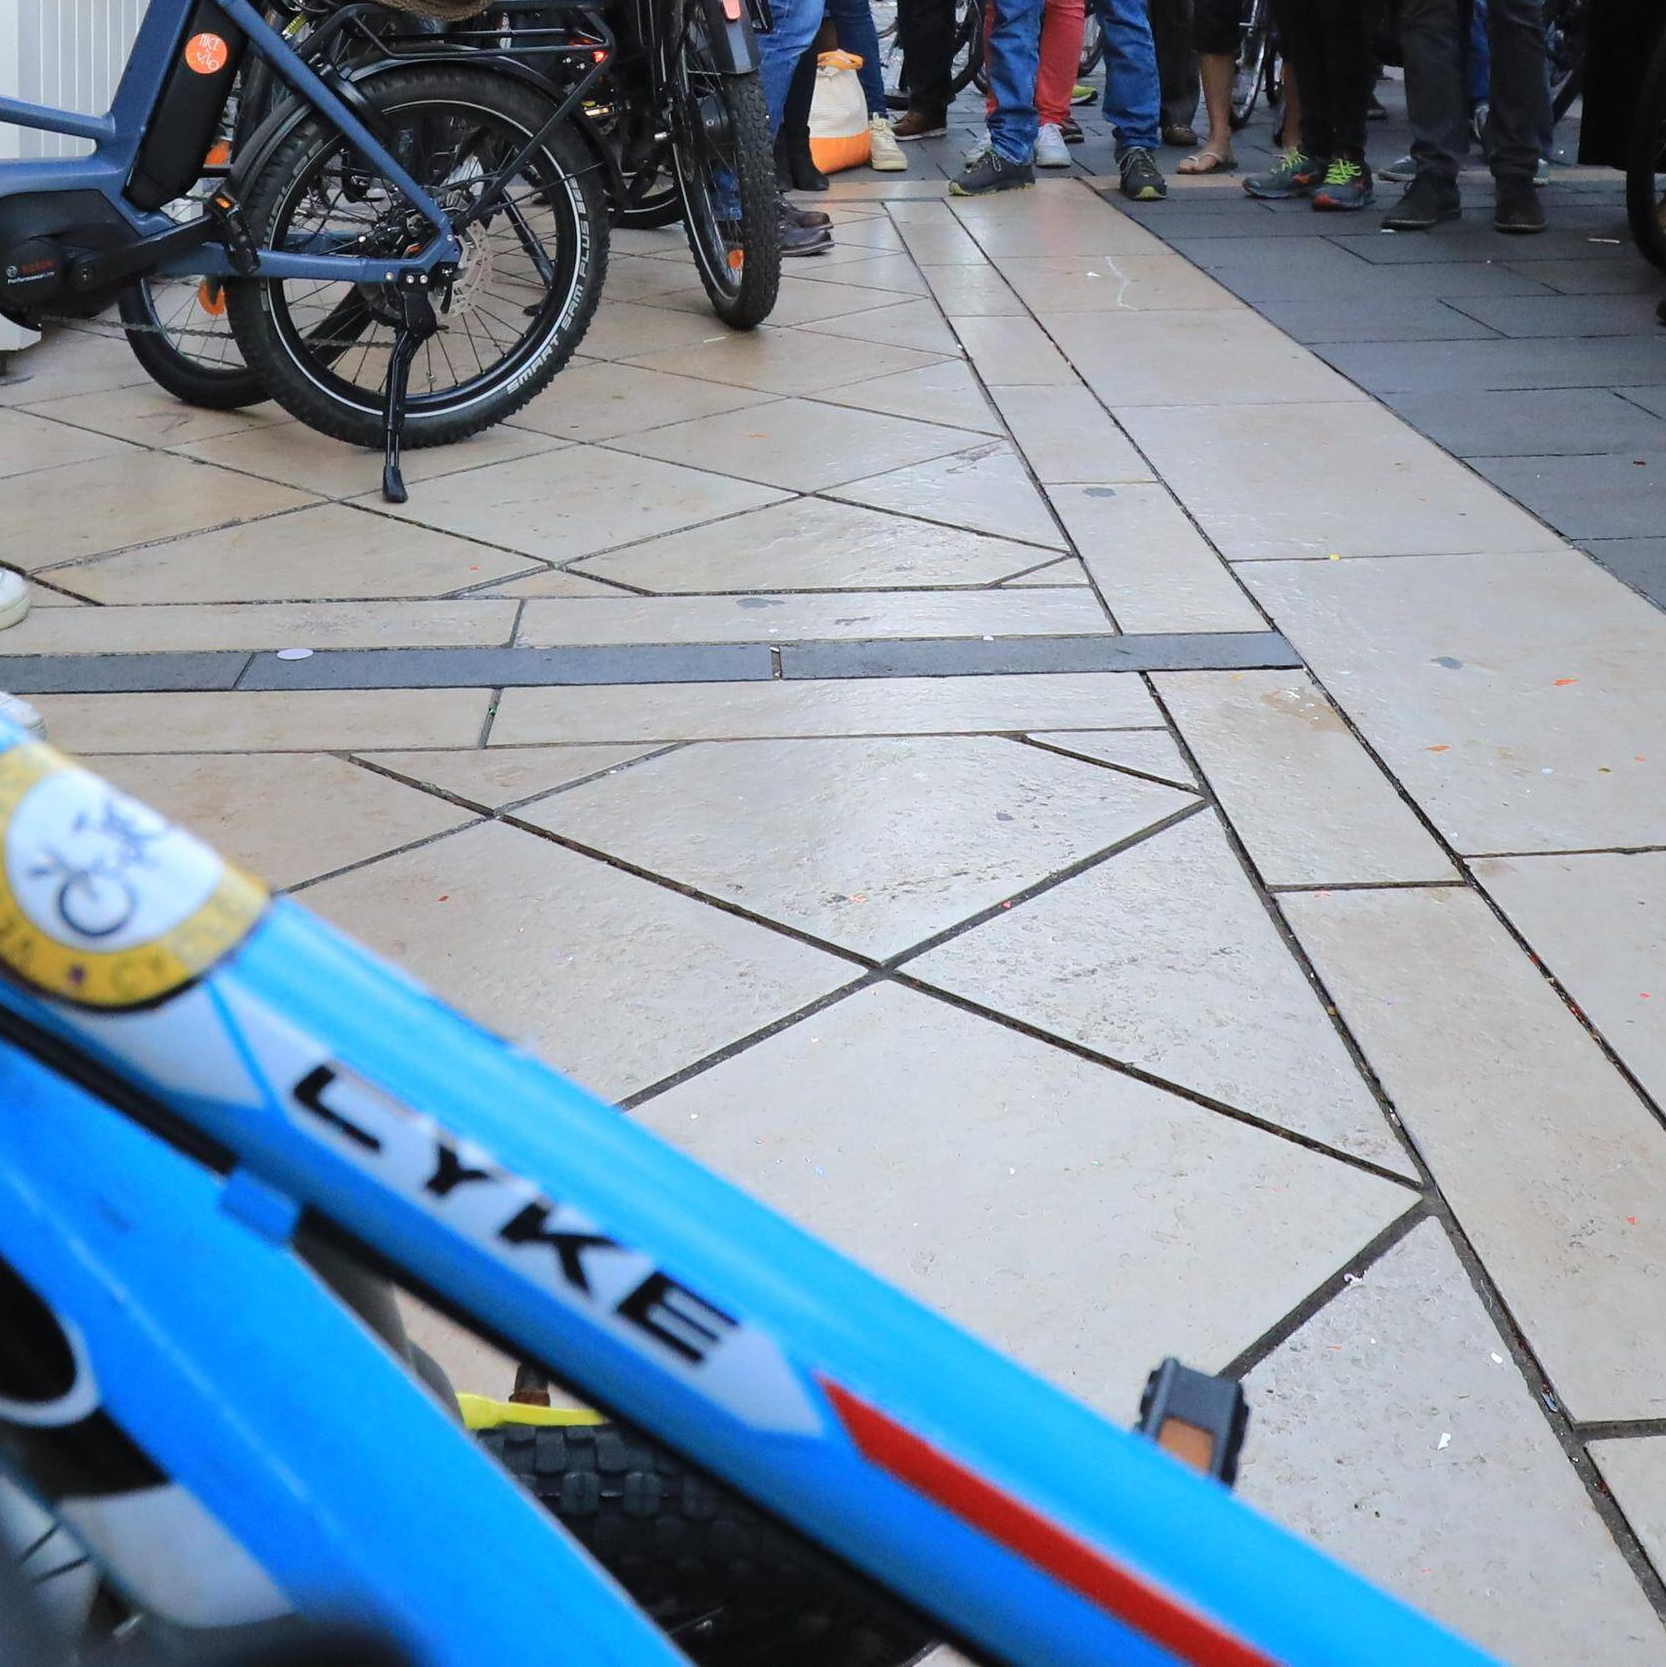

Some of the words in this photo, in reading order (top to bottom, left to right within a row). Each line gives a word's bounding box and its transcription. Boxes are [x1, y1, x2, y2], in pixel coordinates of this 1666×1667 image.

[505, 335, 560, 395] SMART
[561, 285, 585, 332] SAM
[579, 220, 590, 278] PLUS
